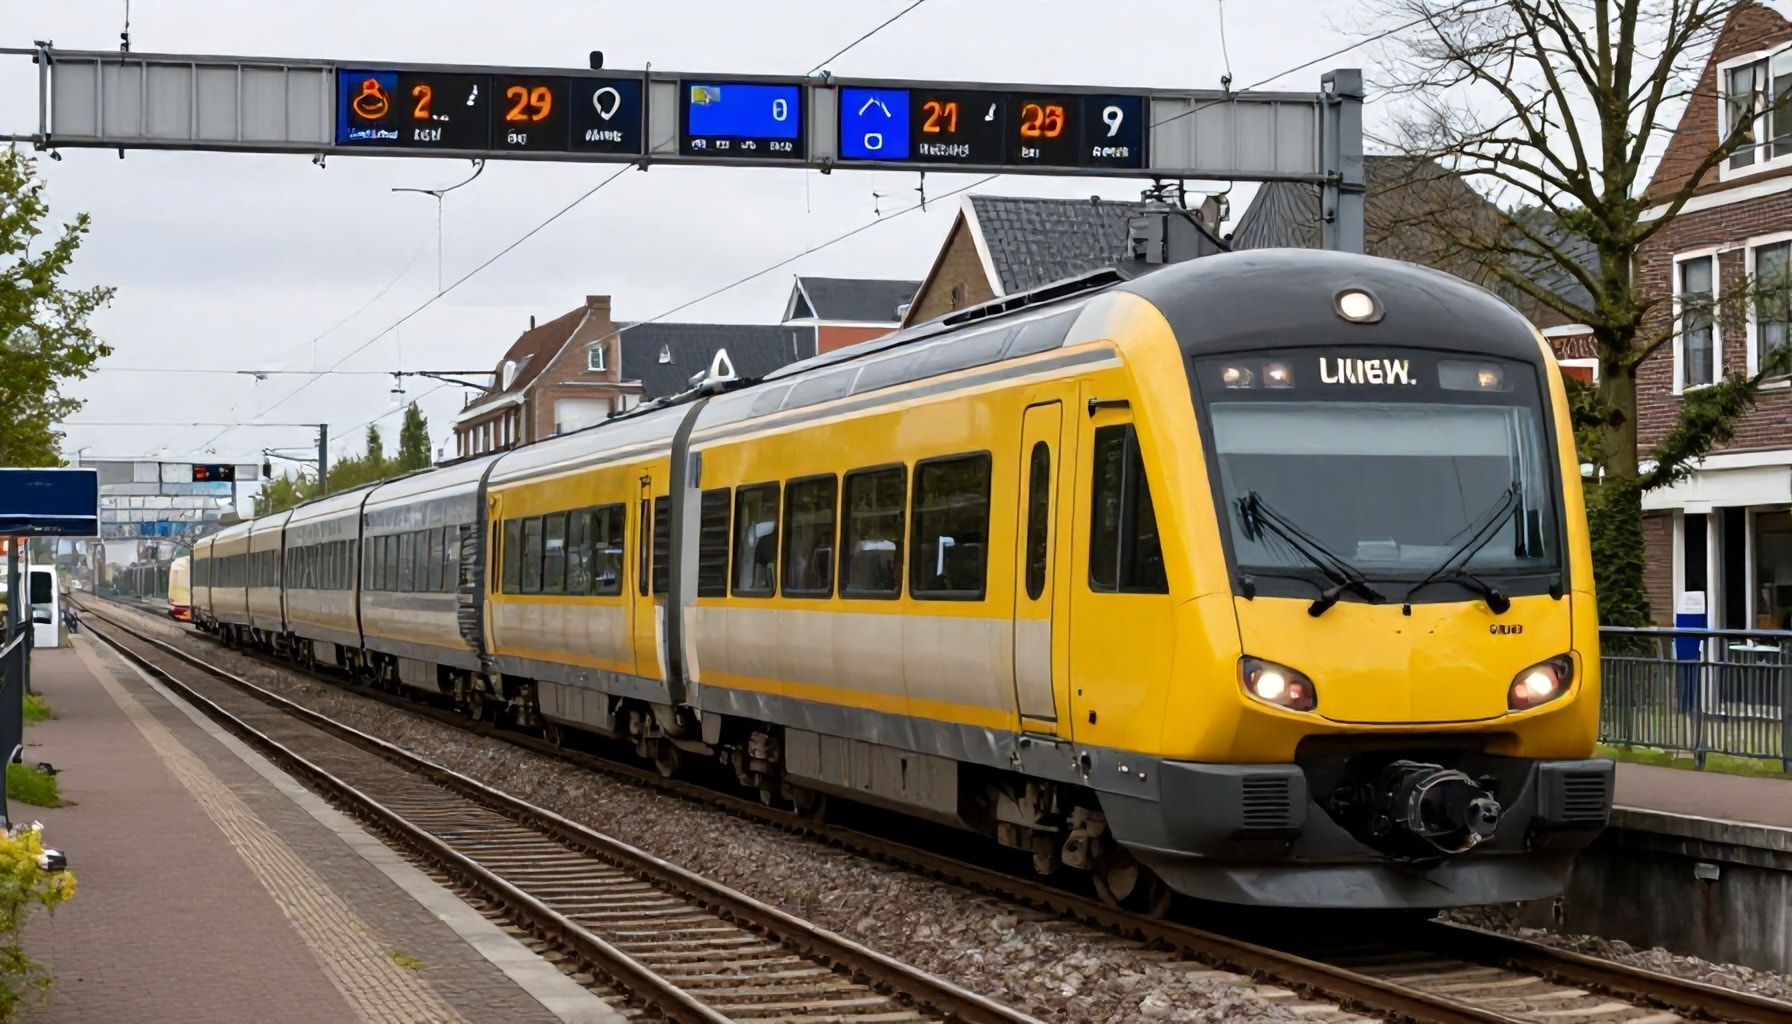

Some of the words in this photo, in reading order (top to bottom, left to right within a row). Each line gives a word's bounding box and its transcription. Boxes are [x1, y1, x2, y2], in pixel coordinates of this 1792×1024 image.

[505, 86, 552, 121] 29
[922, 101, 957, 133] 21
[1102, 105, 1124, 137] 9
